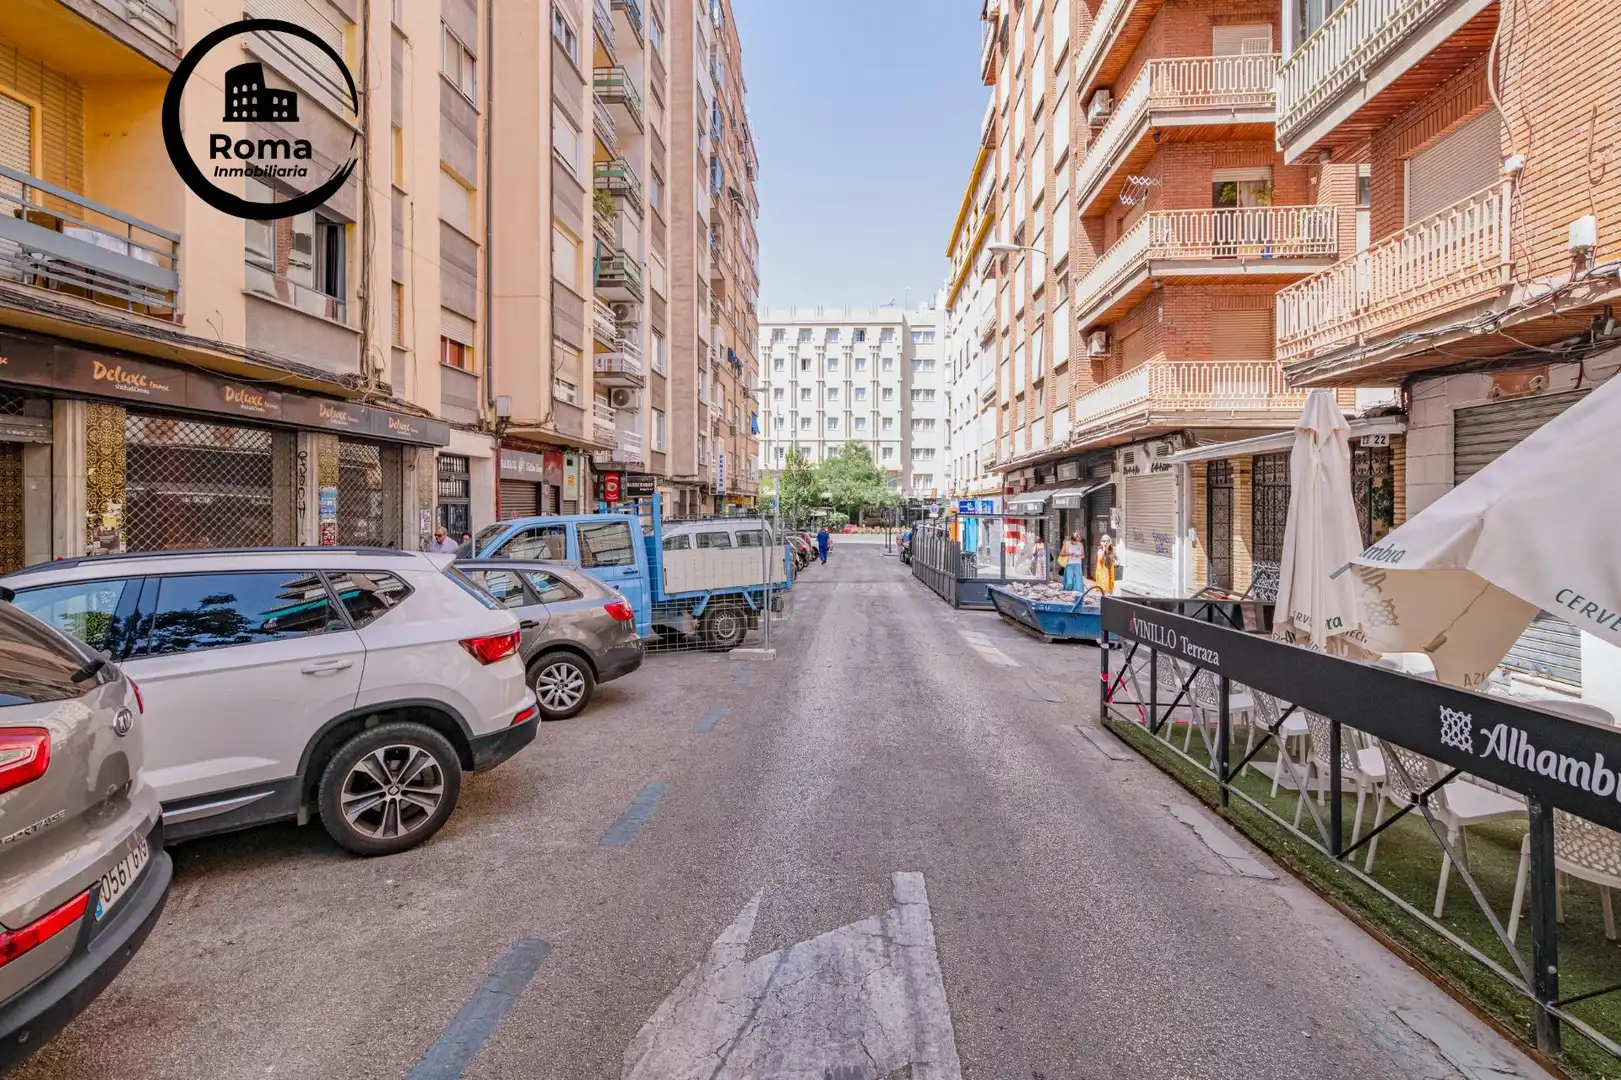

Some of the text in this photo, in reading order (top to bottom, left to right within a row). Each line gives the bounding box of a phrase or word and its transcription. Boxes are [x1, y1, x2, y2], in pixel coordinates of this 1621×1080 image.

[92, 360, 147, 387] Deluxe
[224, 385, 264, 406] Deluxe
[1374, 435, 1386, 445] 22
[1359, 543, 1406, 563] mbra
[1180, 635, 1220, 666] Terraza
[101, 856, 132, 903] 0567
